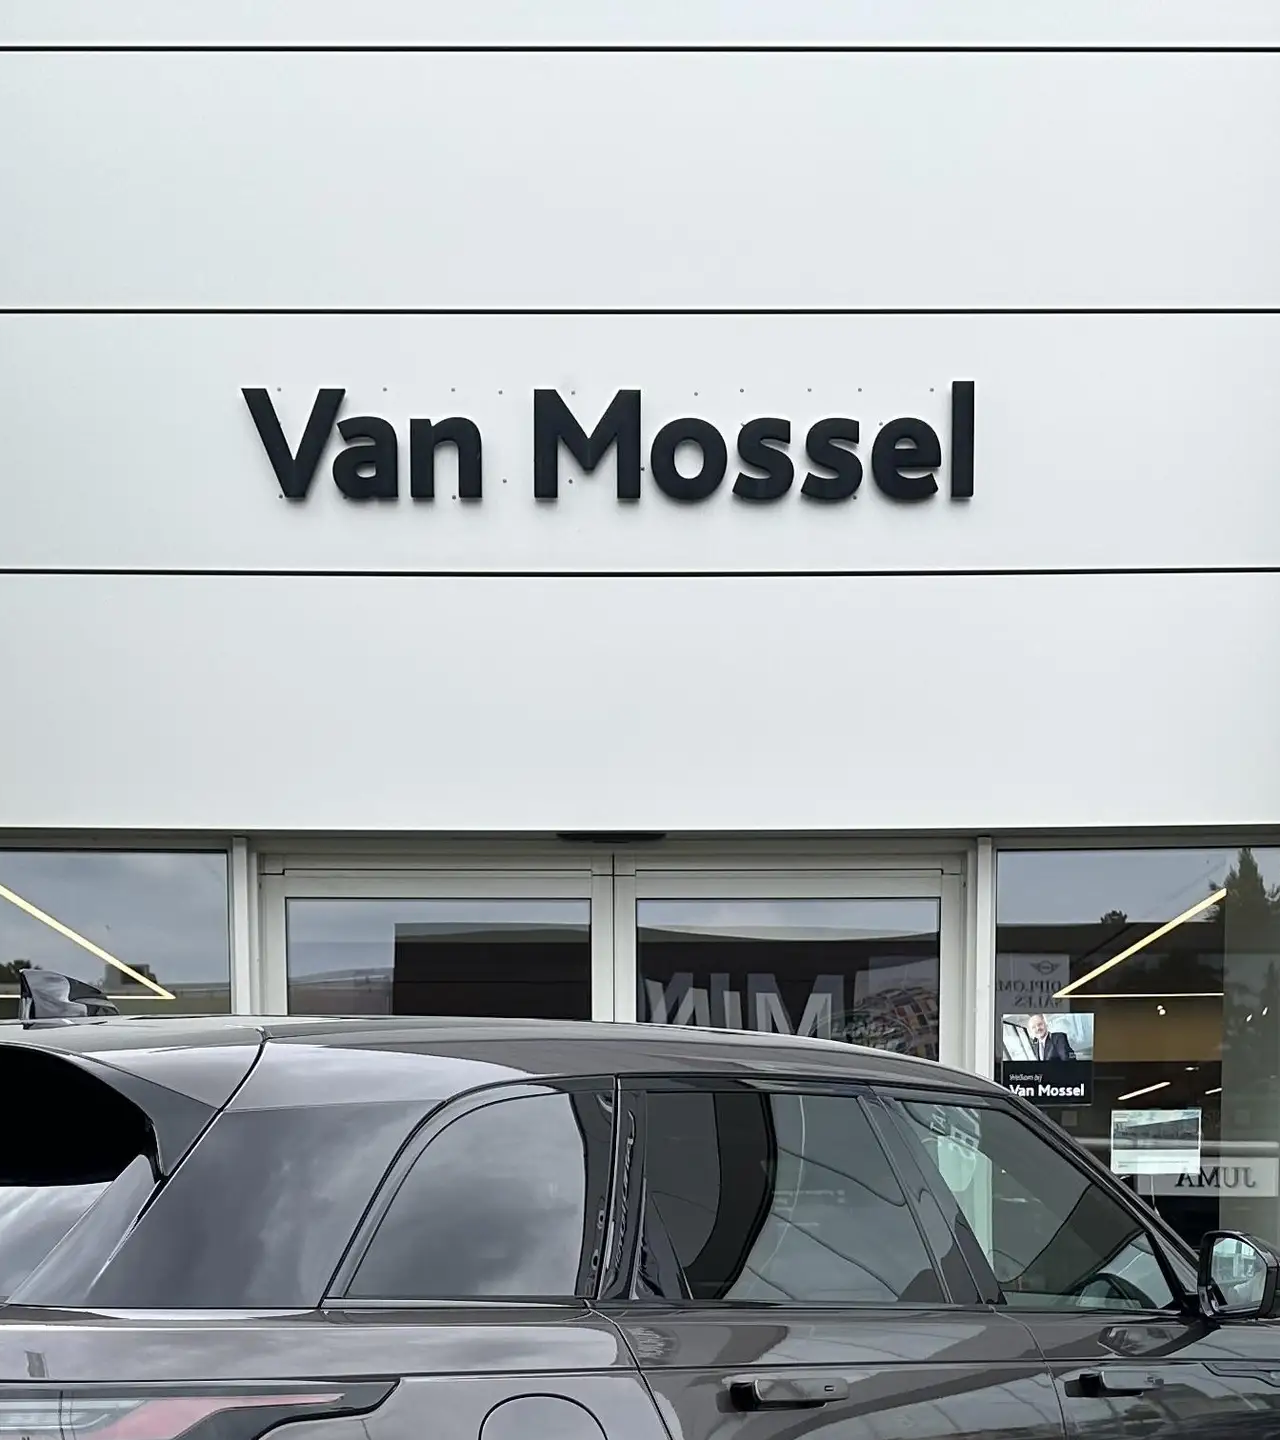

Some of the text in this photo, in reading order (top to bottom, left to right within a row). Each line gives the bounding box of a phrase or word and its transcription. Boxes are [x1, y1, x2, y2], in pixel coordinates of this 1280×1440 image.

[241, 380, 975, 502] Van Mossel
[1009, 1083, 1085, 1097] Van Mossel
